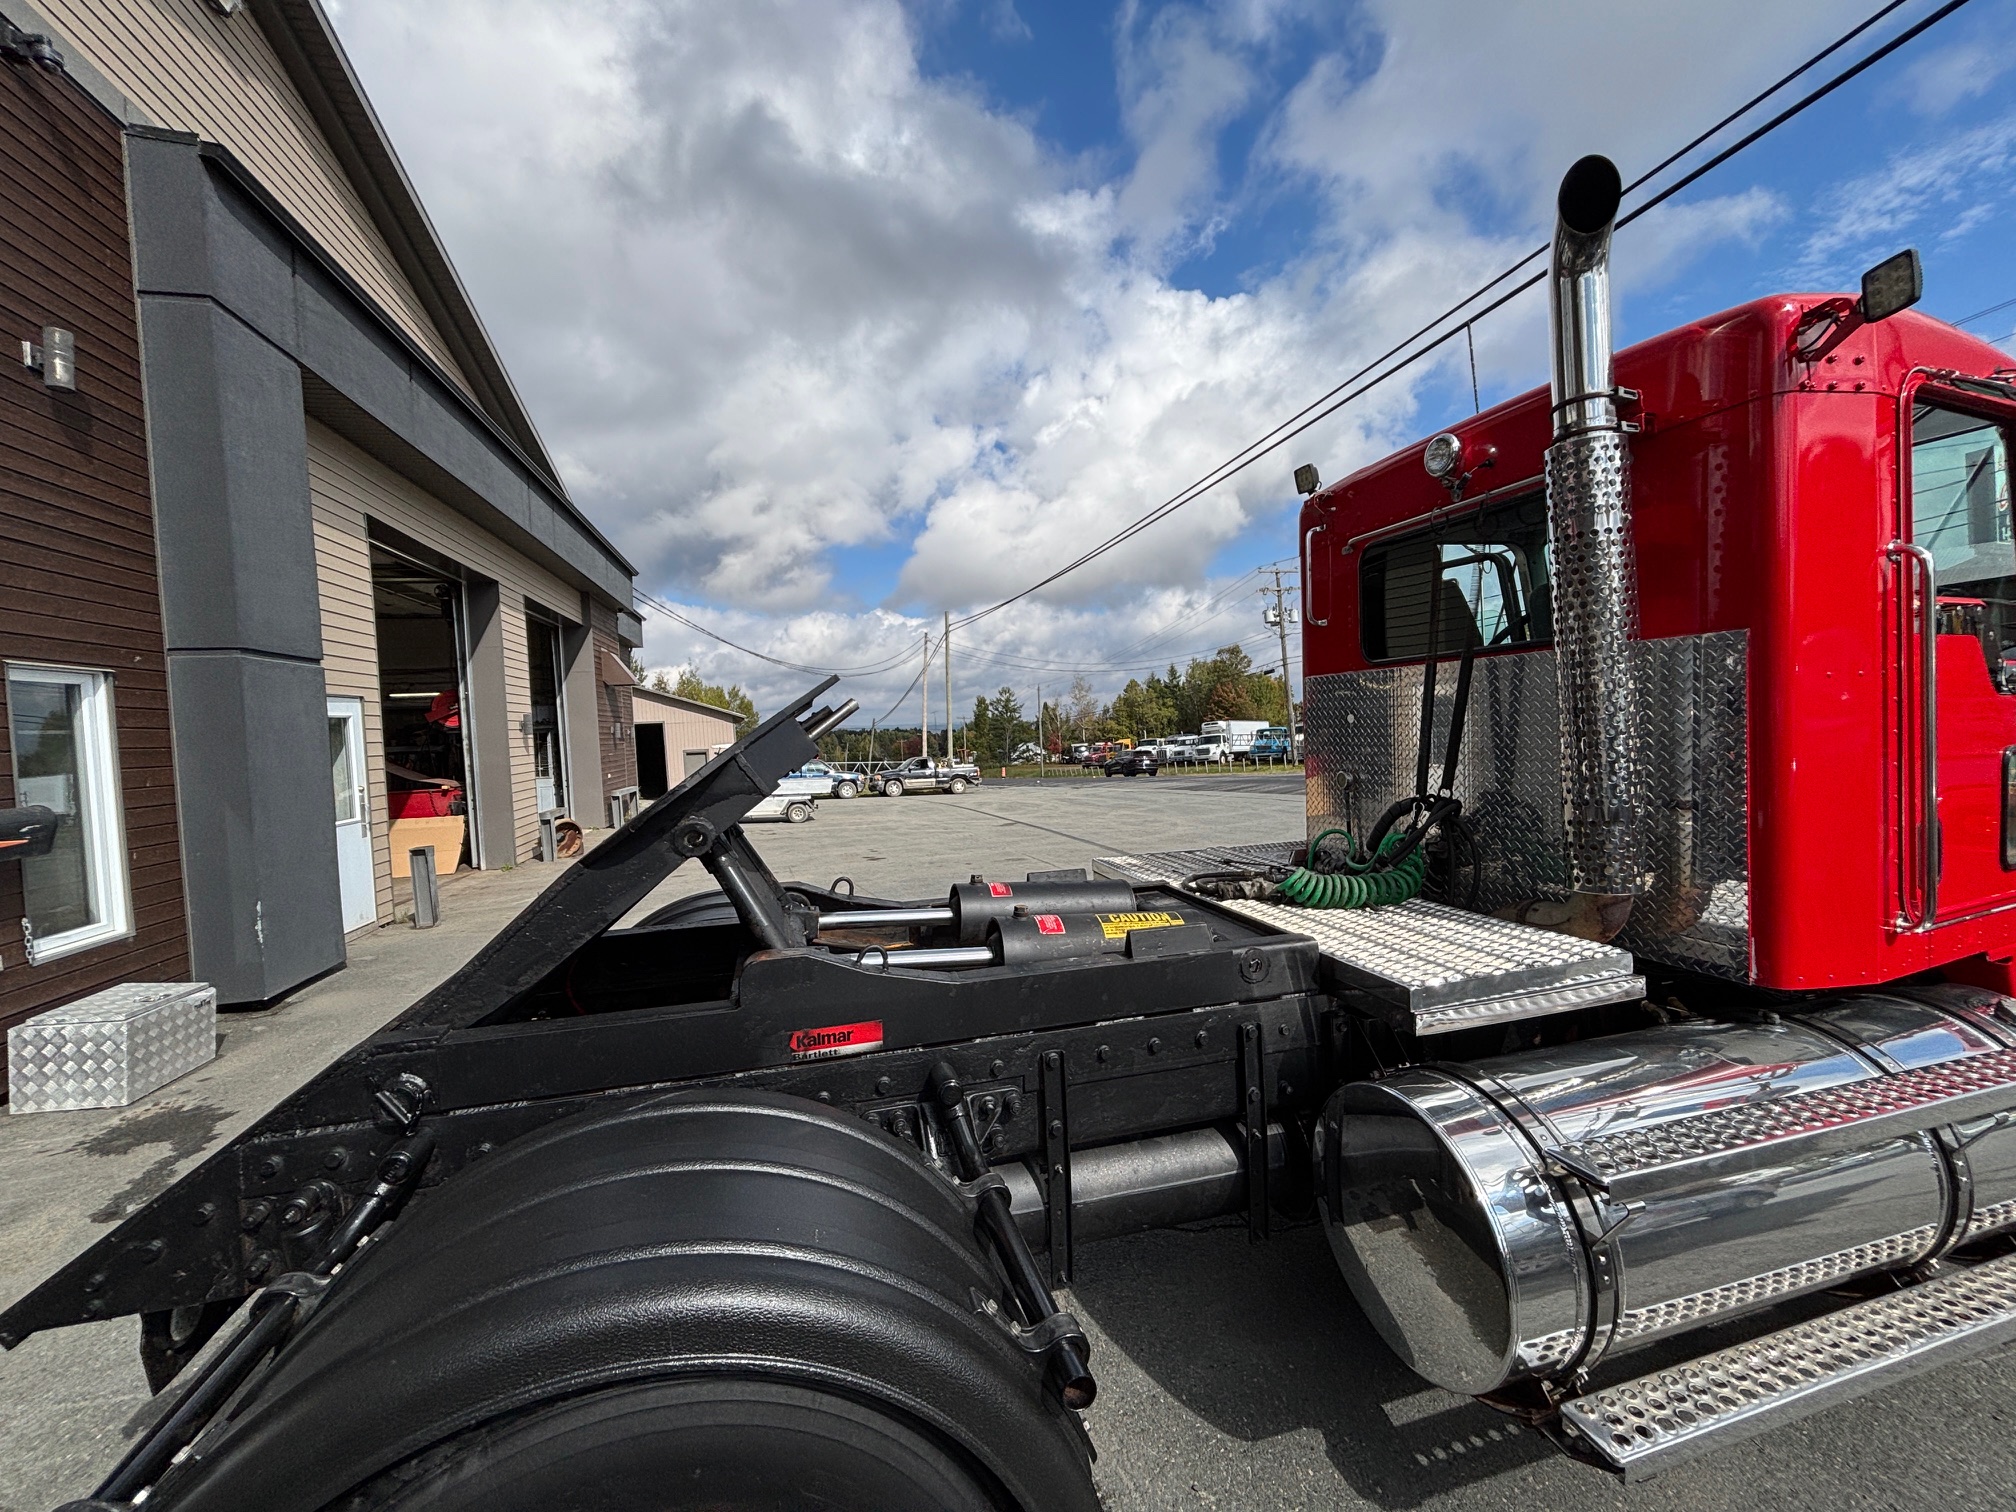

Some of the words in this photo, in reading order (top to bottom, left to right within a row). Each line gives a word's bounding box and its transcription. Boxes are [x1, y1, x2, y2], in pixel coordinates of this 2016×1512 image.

[1108, 912, 1172, 923] CAUTION
[796, 1029, 855, 1049] Kalmar
[793, 1049, 838, 1061] Bartlett
